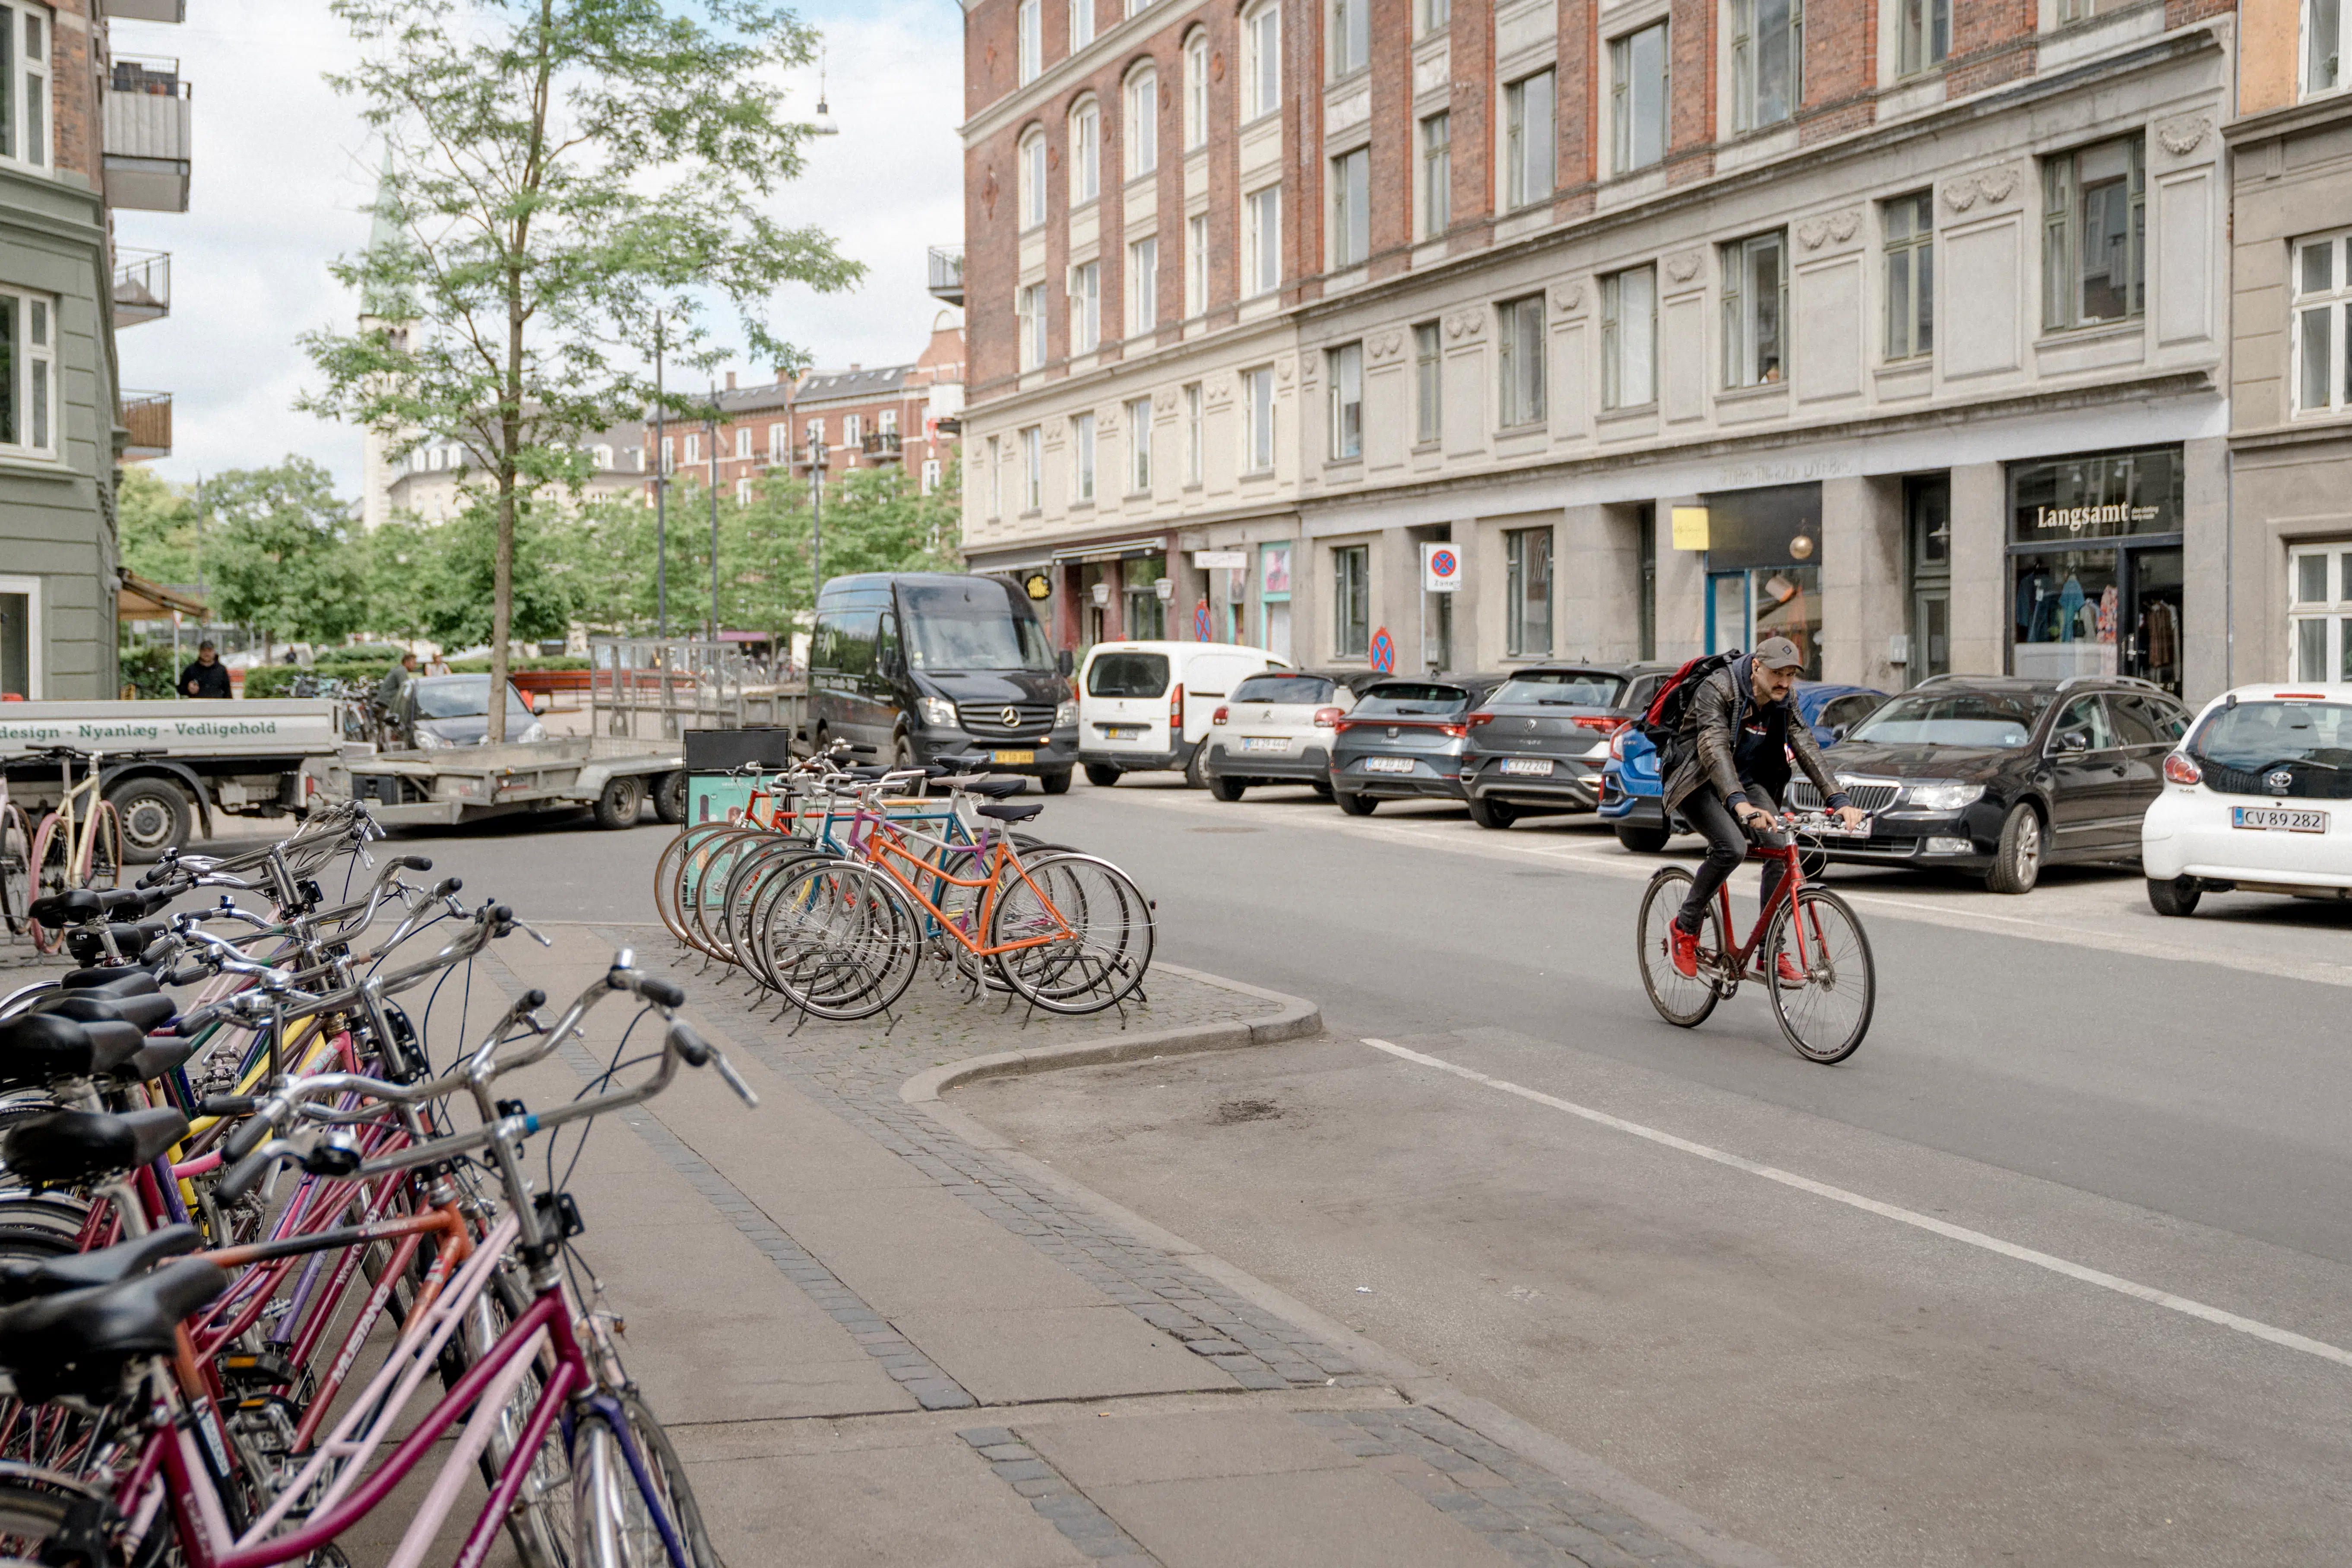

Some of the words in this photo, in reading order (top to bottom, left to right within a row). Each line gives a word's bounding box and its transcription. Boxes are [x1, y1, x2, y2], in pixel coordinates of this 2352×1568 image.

[2038, 501, 2129, 531] Langsamt
[0, 725, 60, 742] design
[79, 722, 158, 741] Nyanlæg
[174, 721, 277, 738] Vedligehold
[2245, 811, 2265, 824] CV
[2269, 812, 2288, 826] 89
[2292, 814, 2321, 828] 282
[331, 1282, 390, 1384] MUSTANG
